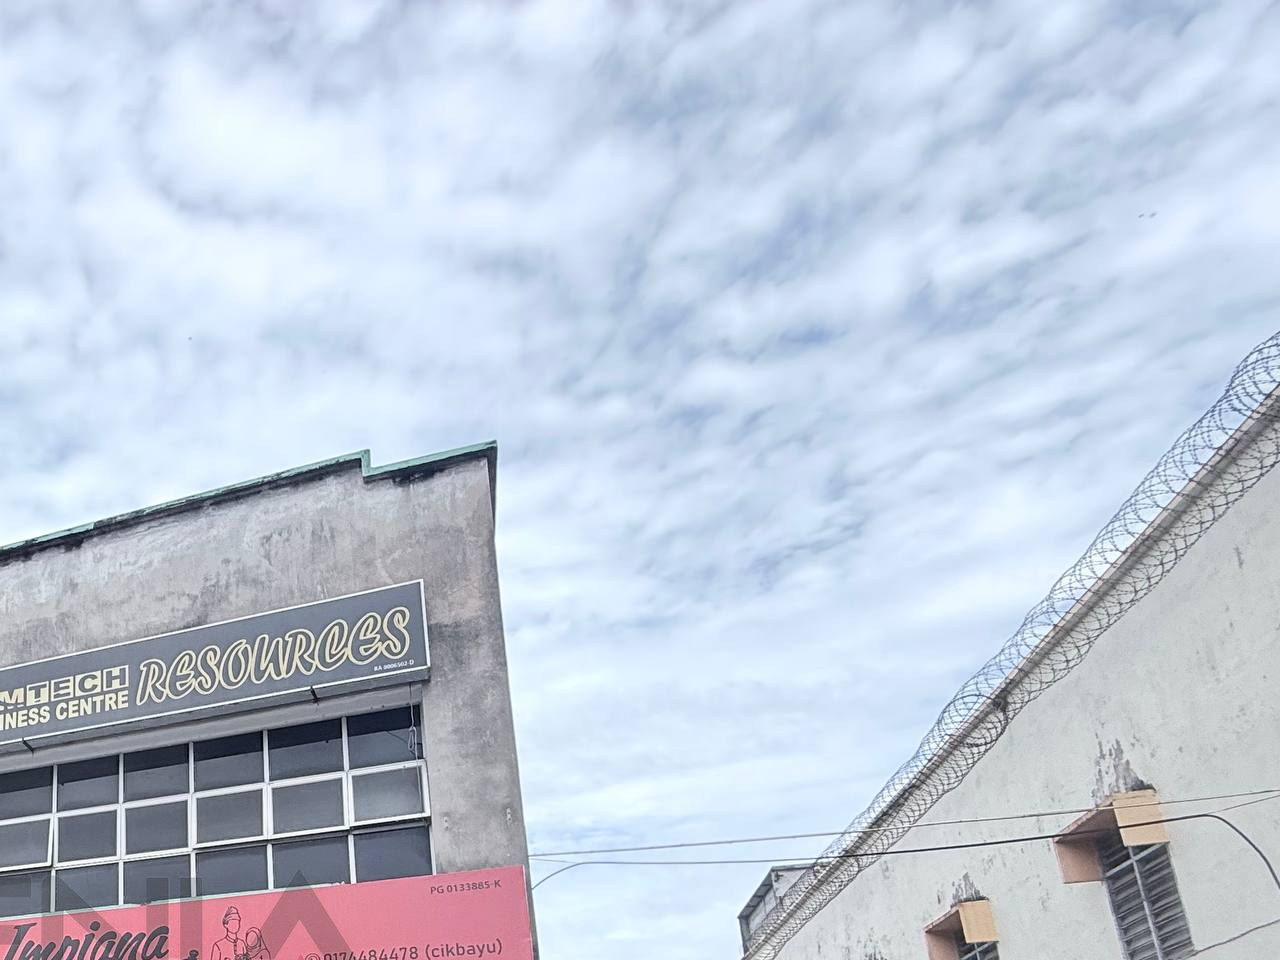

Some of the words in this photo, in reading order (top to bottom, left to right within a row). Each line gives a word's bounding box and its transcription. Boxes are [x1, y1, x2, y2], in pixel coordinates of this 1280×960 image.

[136, 606, 410, 705] RESOURCES
[55, 691, 129, 720] CENTRE
[430, 885, 445, 895] PG
[446, 879, 503, 893] 0133885-K
[425, 938, 503, 960] (cikbayu)
